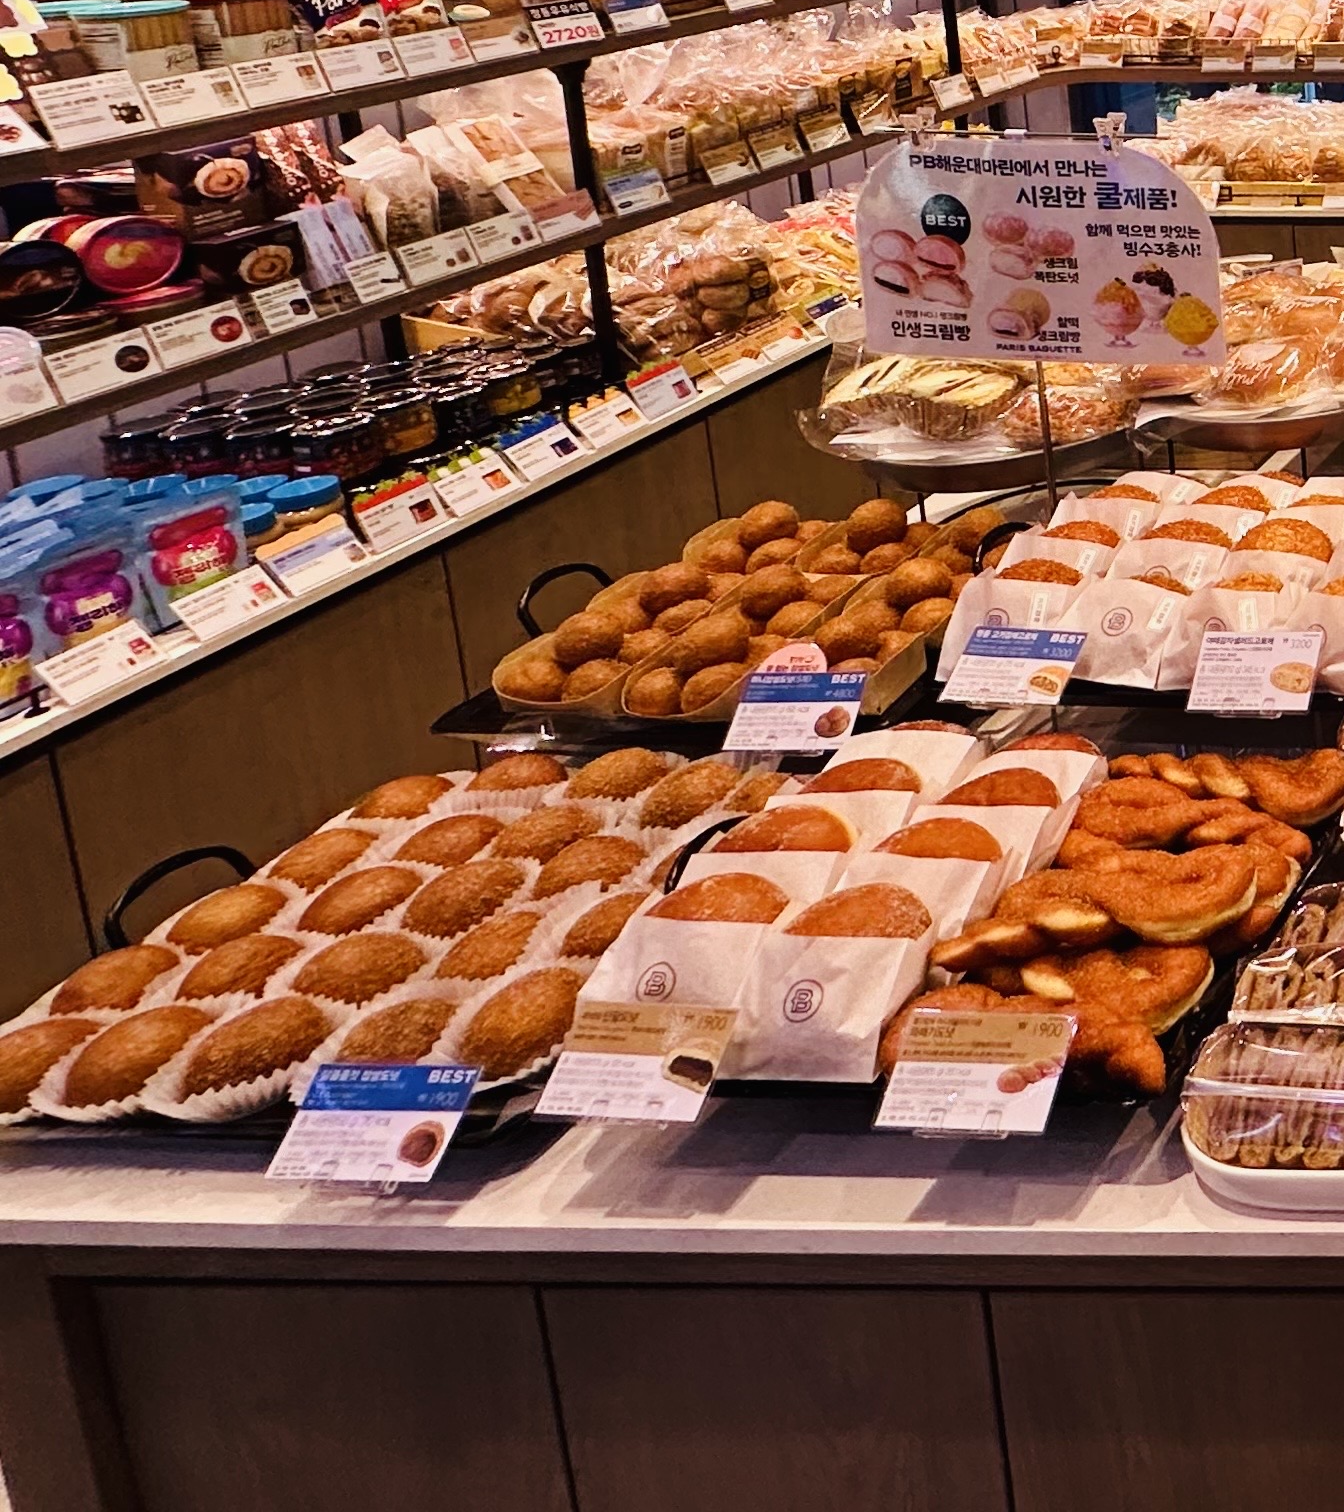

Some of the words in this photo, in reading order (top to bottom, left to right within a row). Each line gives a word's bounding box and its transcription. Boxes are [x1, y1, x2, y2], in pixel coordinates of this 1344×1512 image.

[543, 24, 599, 44] 2720원
[909, 153, 1050, 178] PB해운대마린에서
[1055, 158, 1108, 178] 만나는
[1015, 184, 1087, 209] 시원한
[1094, 181, 1178, 210] 쿨제품!
[924, 213, 967, 228] BEST
[1085, 223, 1113, 238] 함께
[1116, 223, 1157, 238] 먹으면
[1159, 224, 1201, 239] 맛있는
[891, 320, 971, 342] 인생크림빵
[996, 343, 1026, 353] PARIS
[1028, 343, 1083, 354] BAGUETTE
[1050, 633, 1086, 645] BEST
[831, 673, 867, 684] BEST
[427, 1069, 477, 1083] BEST
